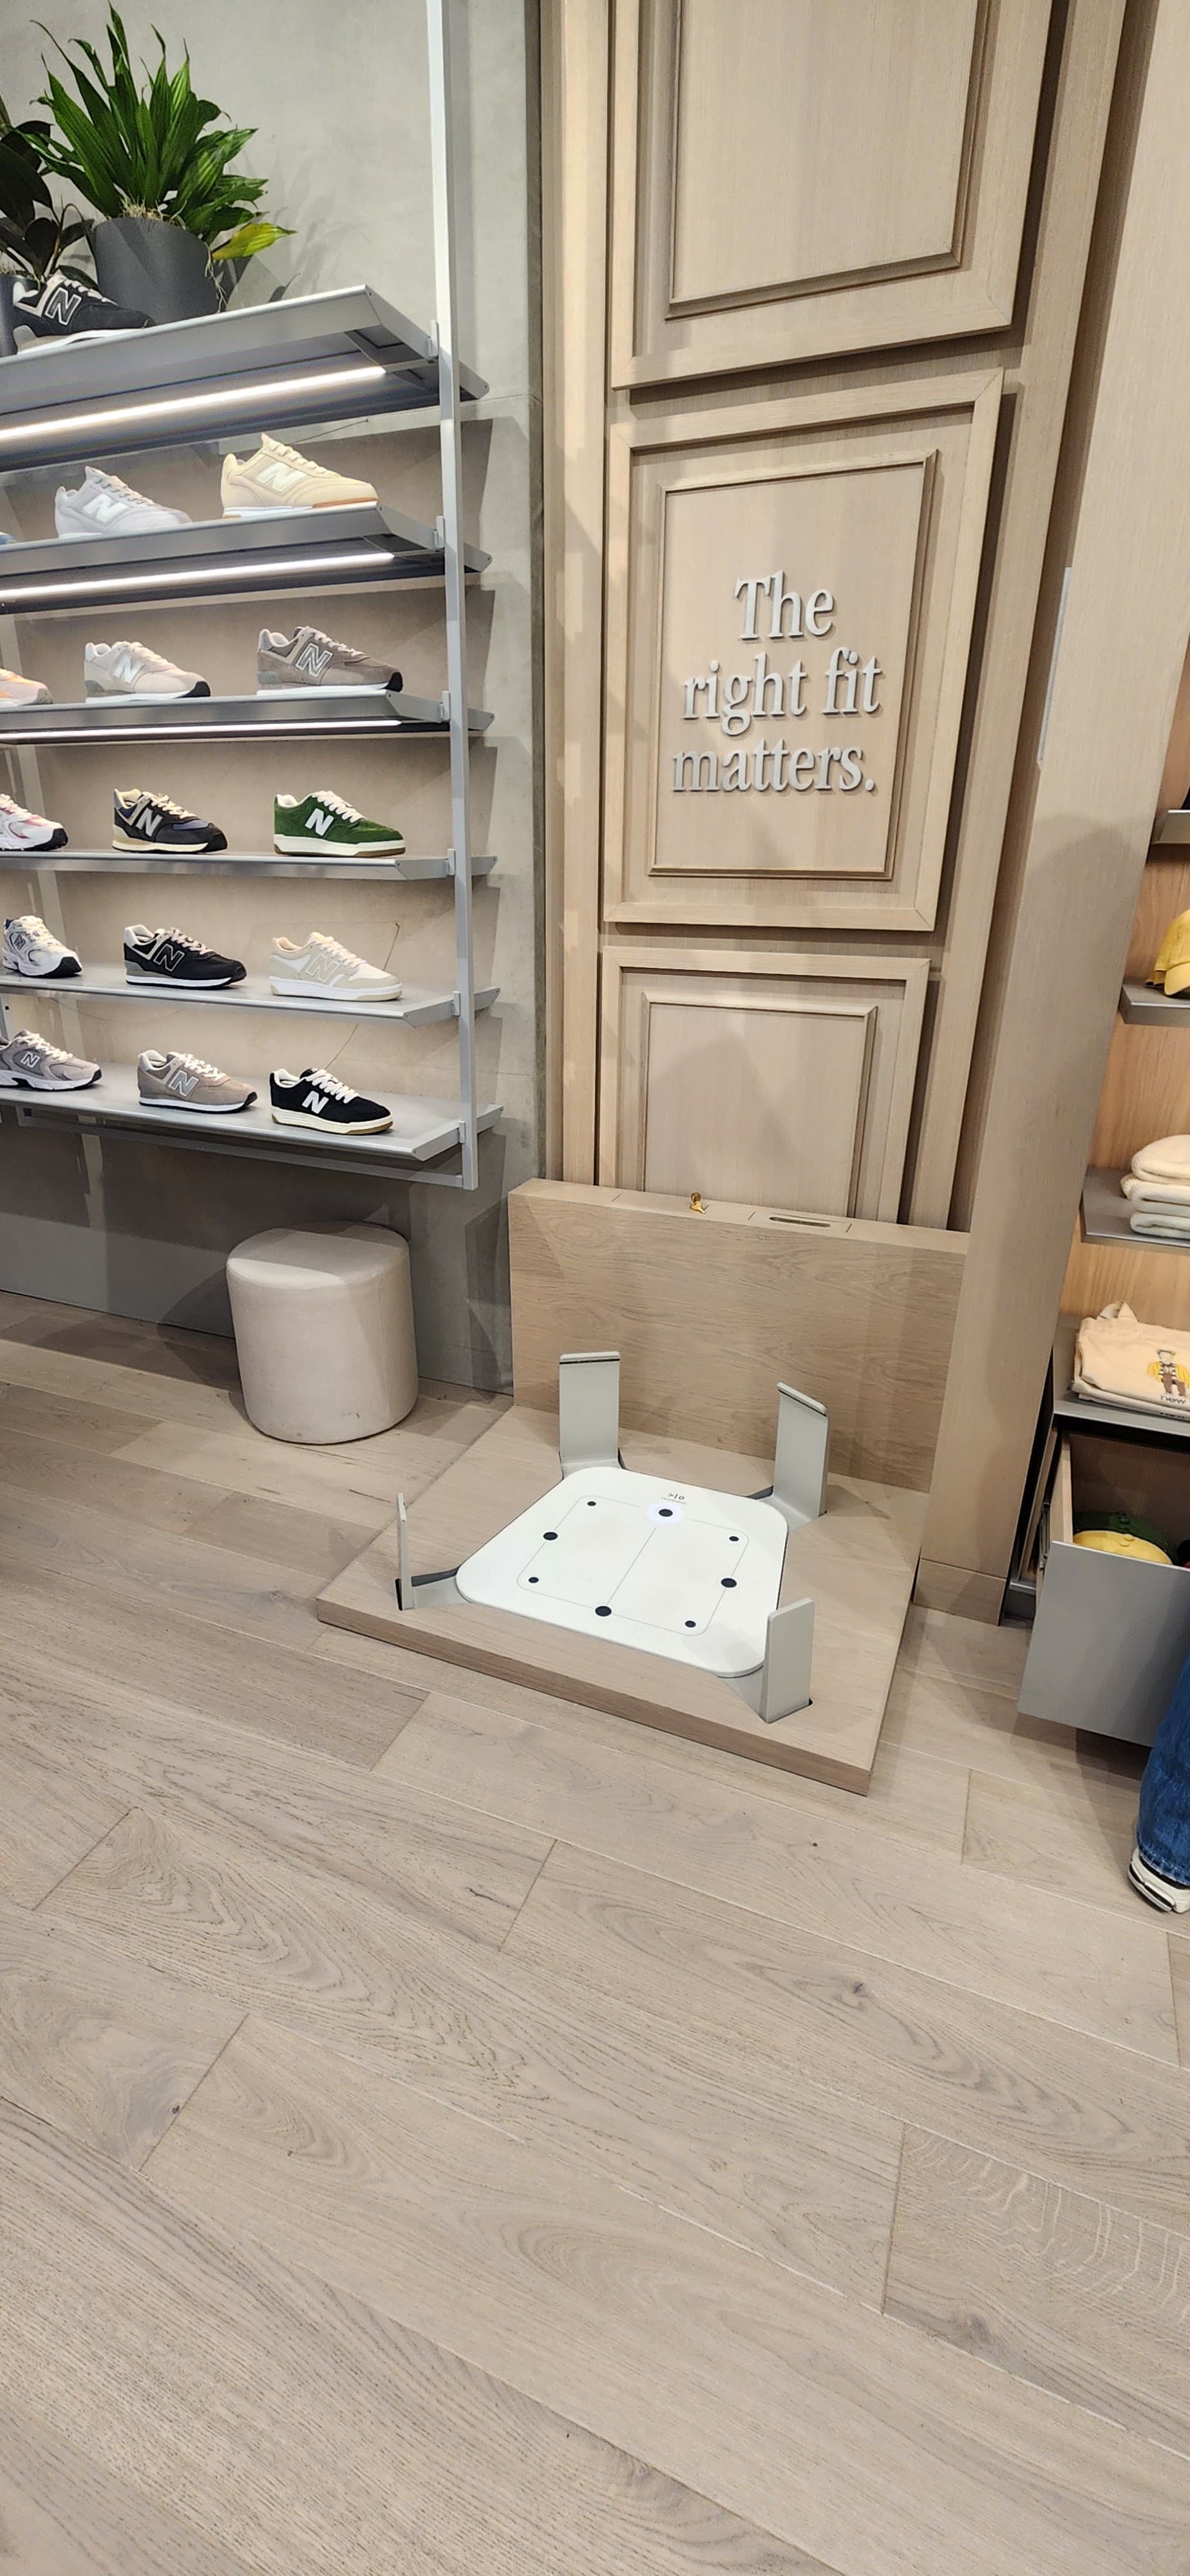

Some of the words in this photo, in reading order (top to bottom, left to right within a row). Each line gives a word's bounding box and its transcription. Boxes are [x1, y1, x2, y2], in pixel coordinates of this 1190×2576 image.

[44, 288, 82, 325] N
[258, 462, 306, 492] N
[83, 495, 128, 523] N
[734, 569, 835, 641] The
[115, 652, 144, 683] N
[295, 643, 334, 677] N
[681, 651, 808, 736] right
[823, 647, 882, 715] fit
[672, 738, 876, 793] matters.
[137, 809, 163, 837] N
[305, 809, 334, 836] N
[14, 936, 26, 950] N
[154, 944, 185, 972] N
[306, 955, 341, 984] N
[21, 1051, 40, 1068] N
[169, 1070, 198, 1097] N
[302, 1091, 329, 1113] N
